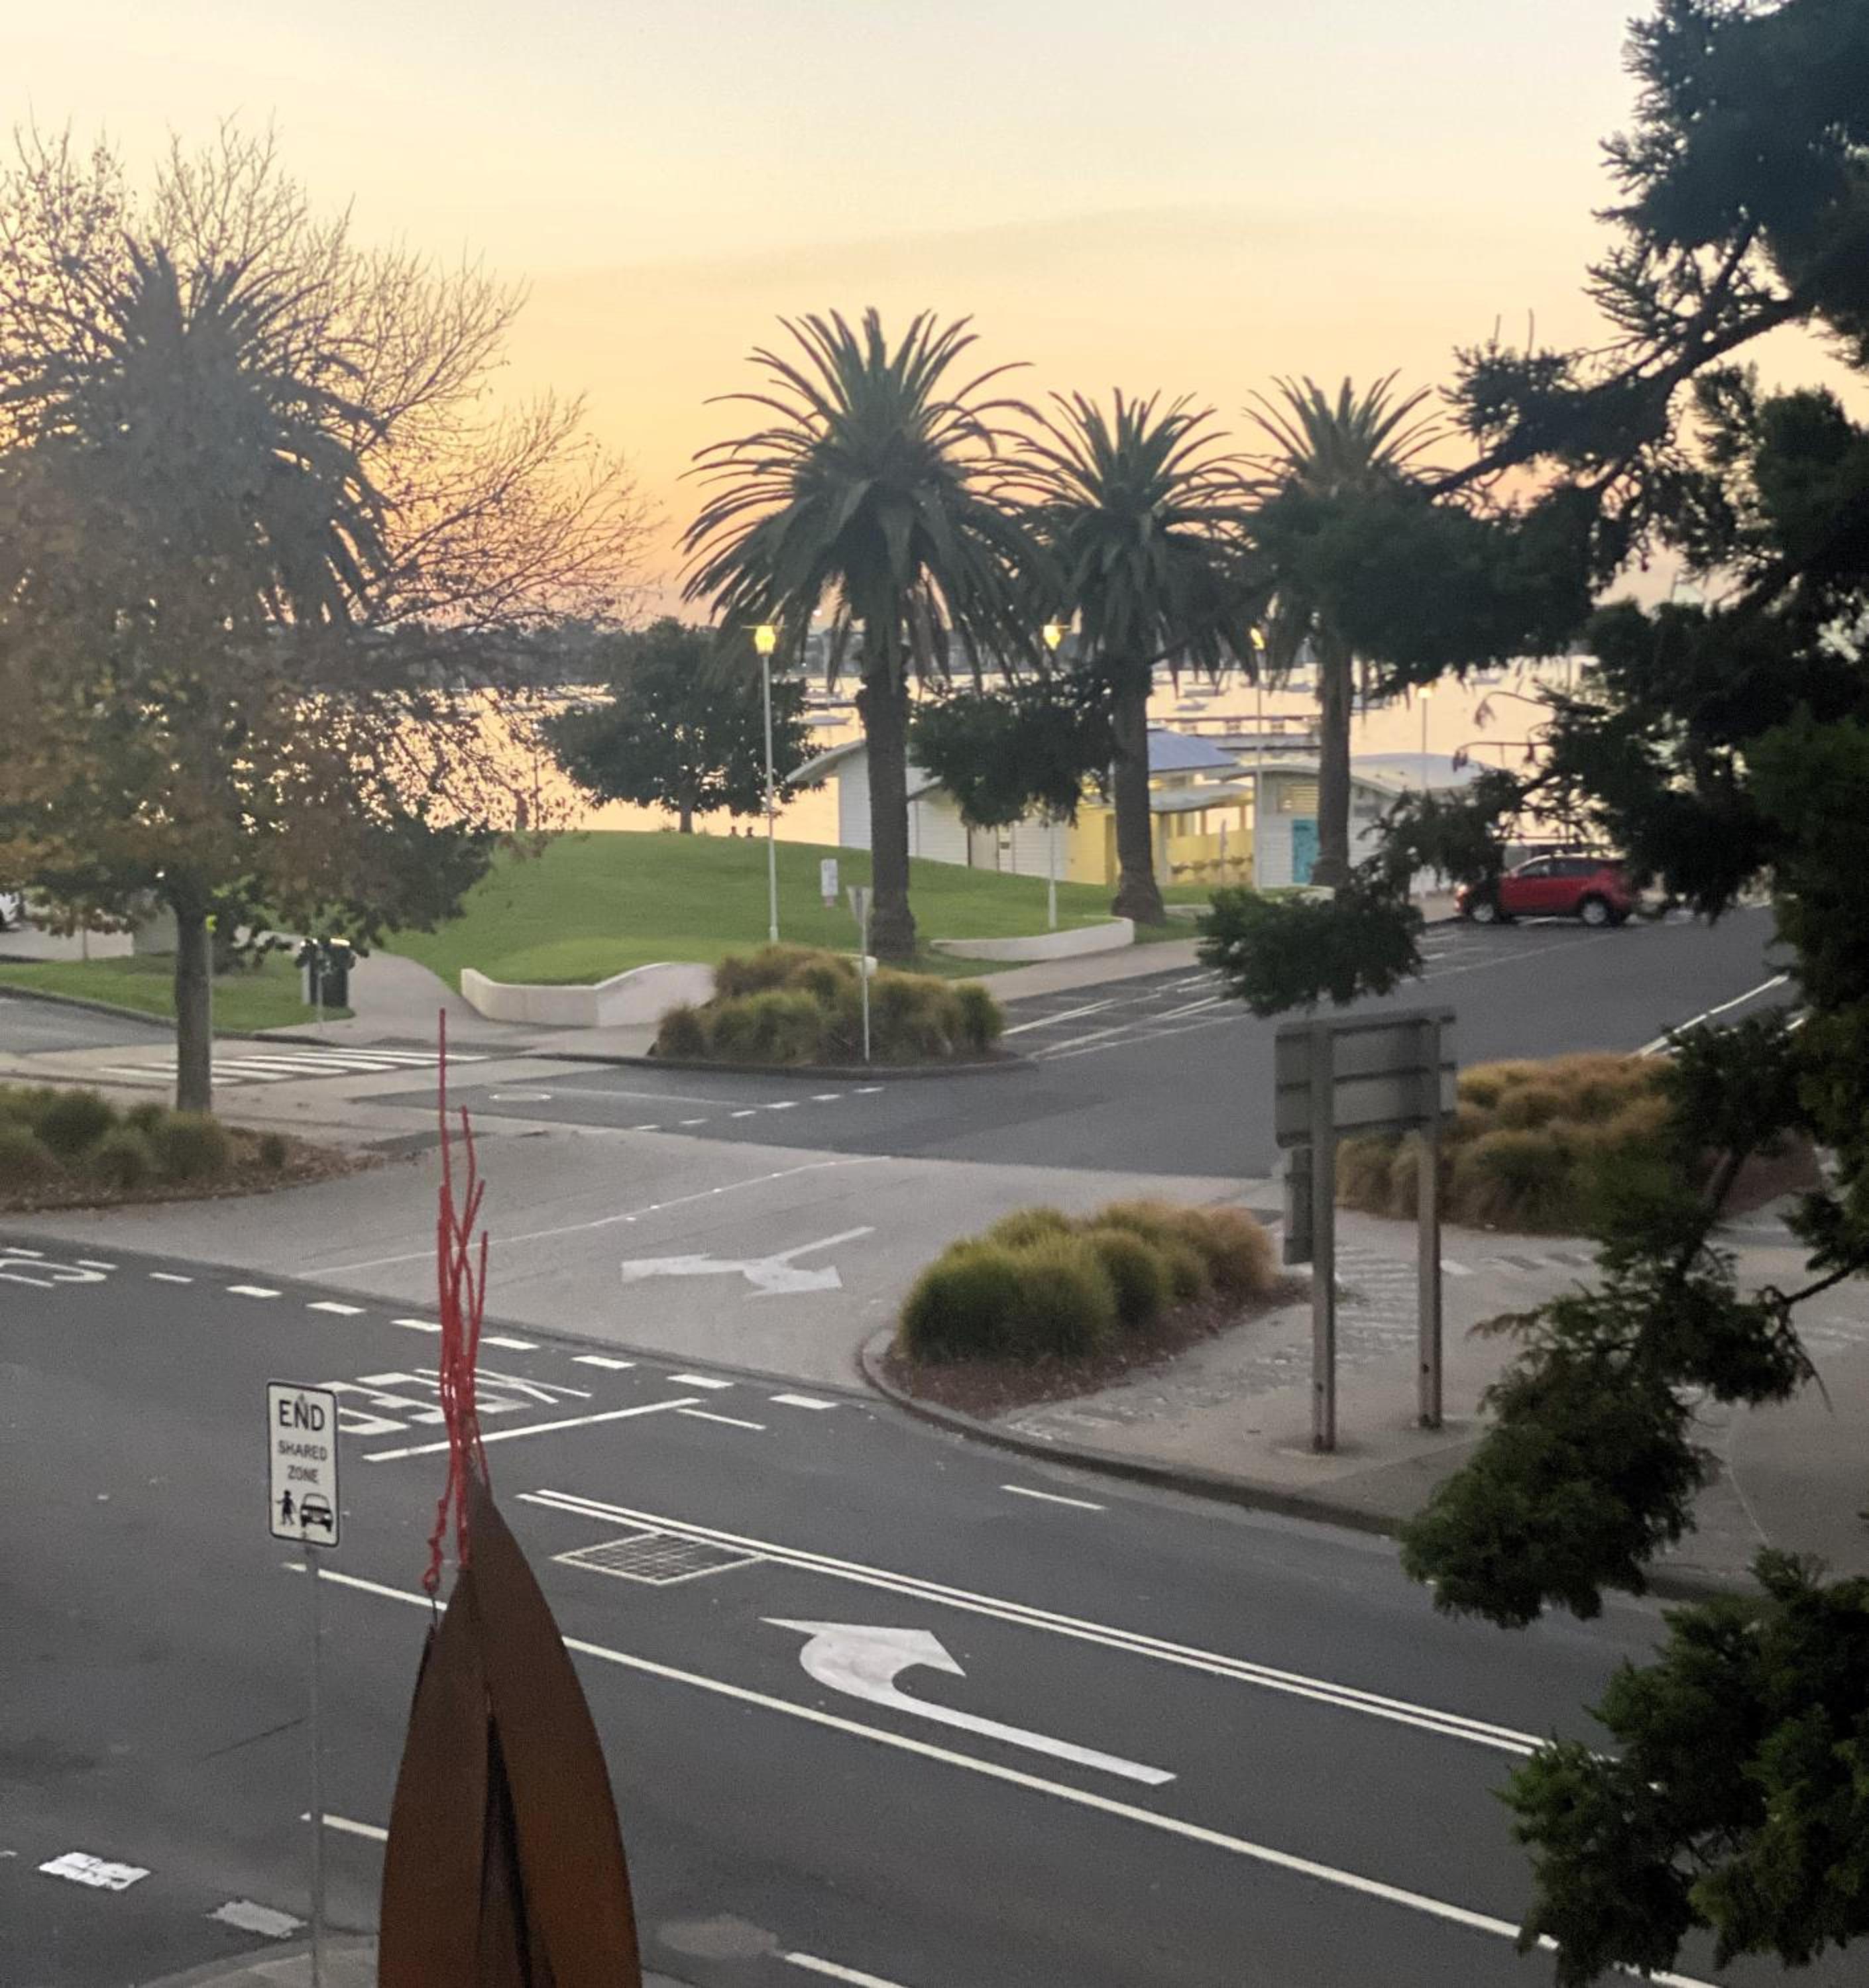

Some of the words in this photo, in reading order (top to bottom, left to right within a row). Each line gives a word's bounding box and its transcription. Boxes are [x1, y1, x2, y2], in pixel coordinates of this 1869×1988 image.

[279, 1399, 325, 1431] END
[278, 1439, 327, 1461] SHARED
[288, 1464, 319, 1483] ZONE
